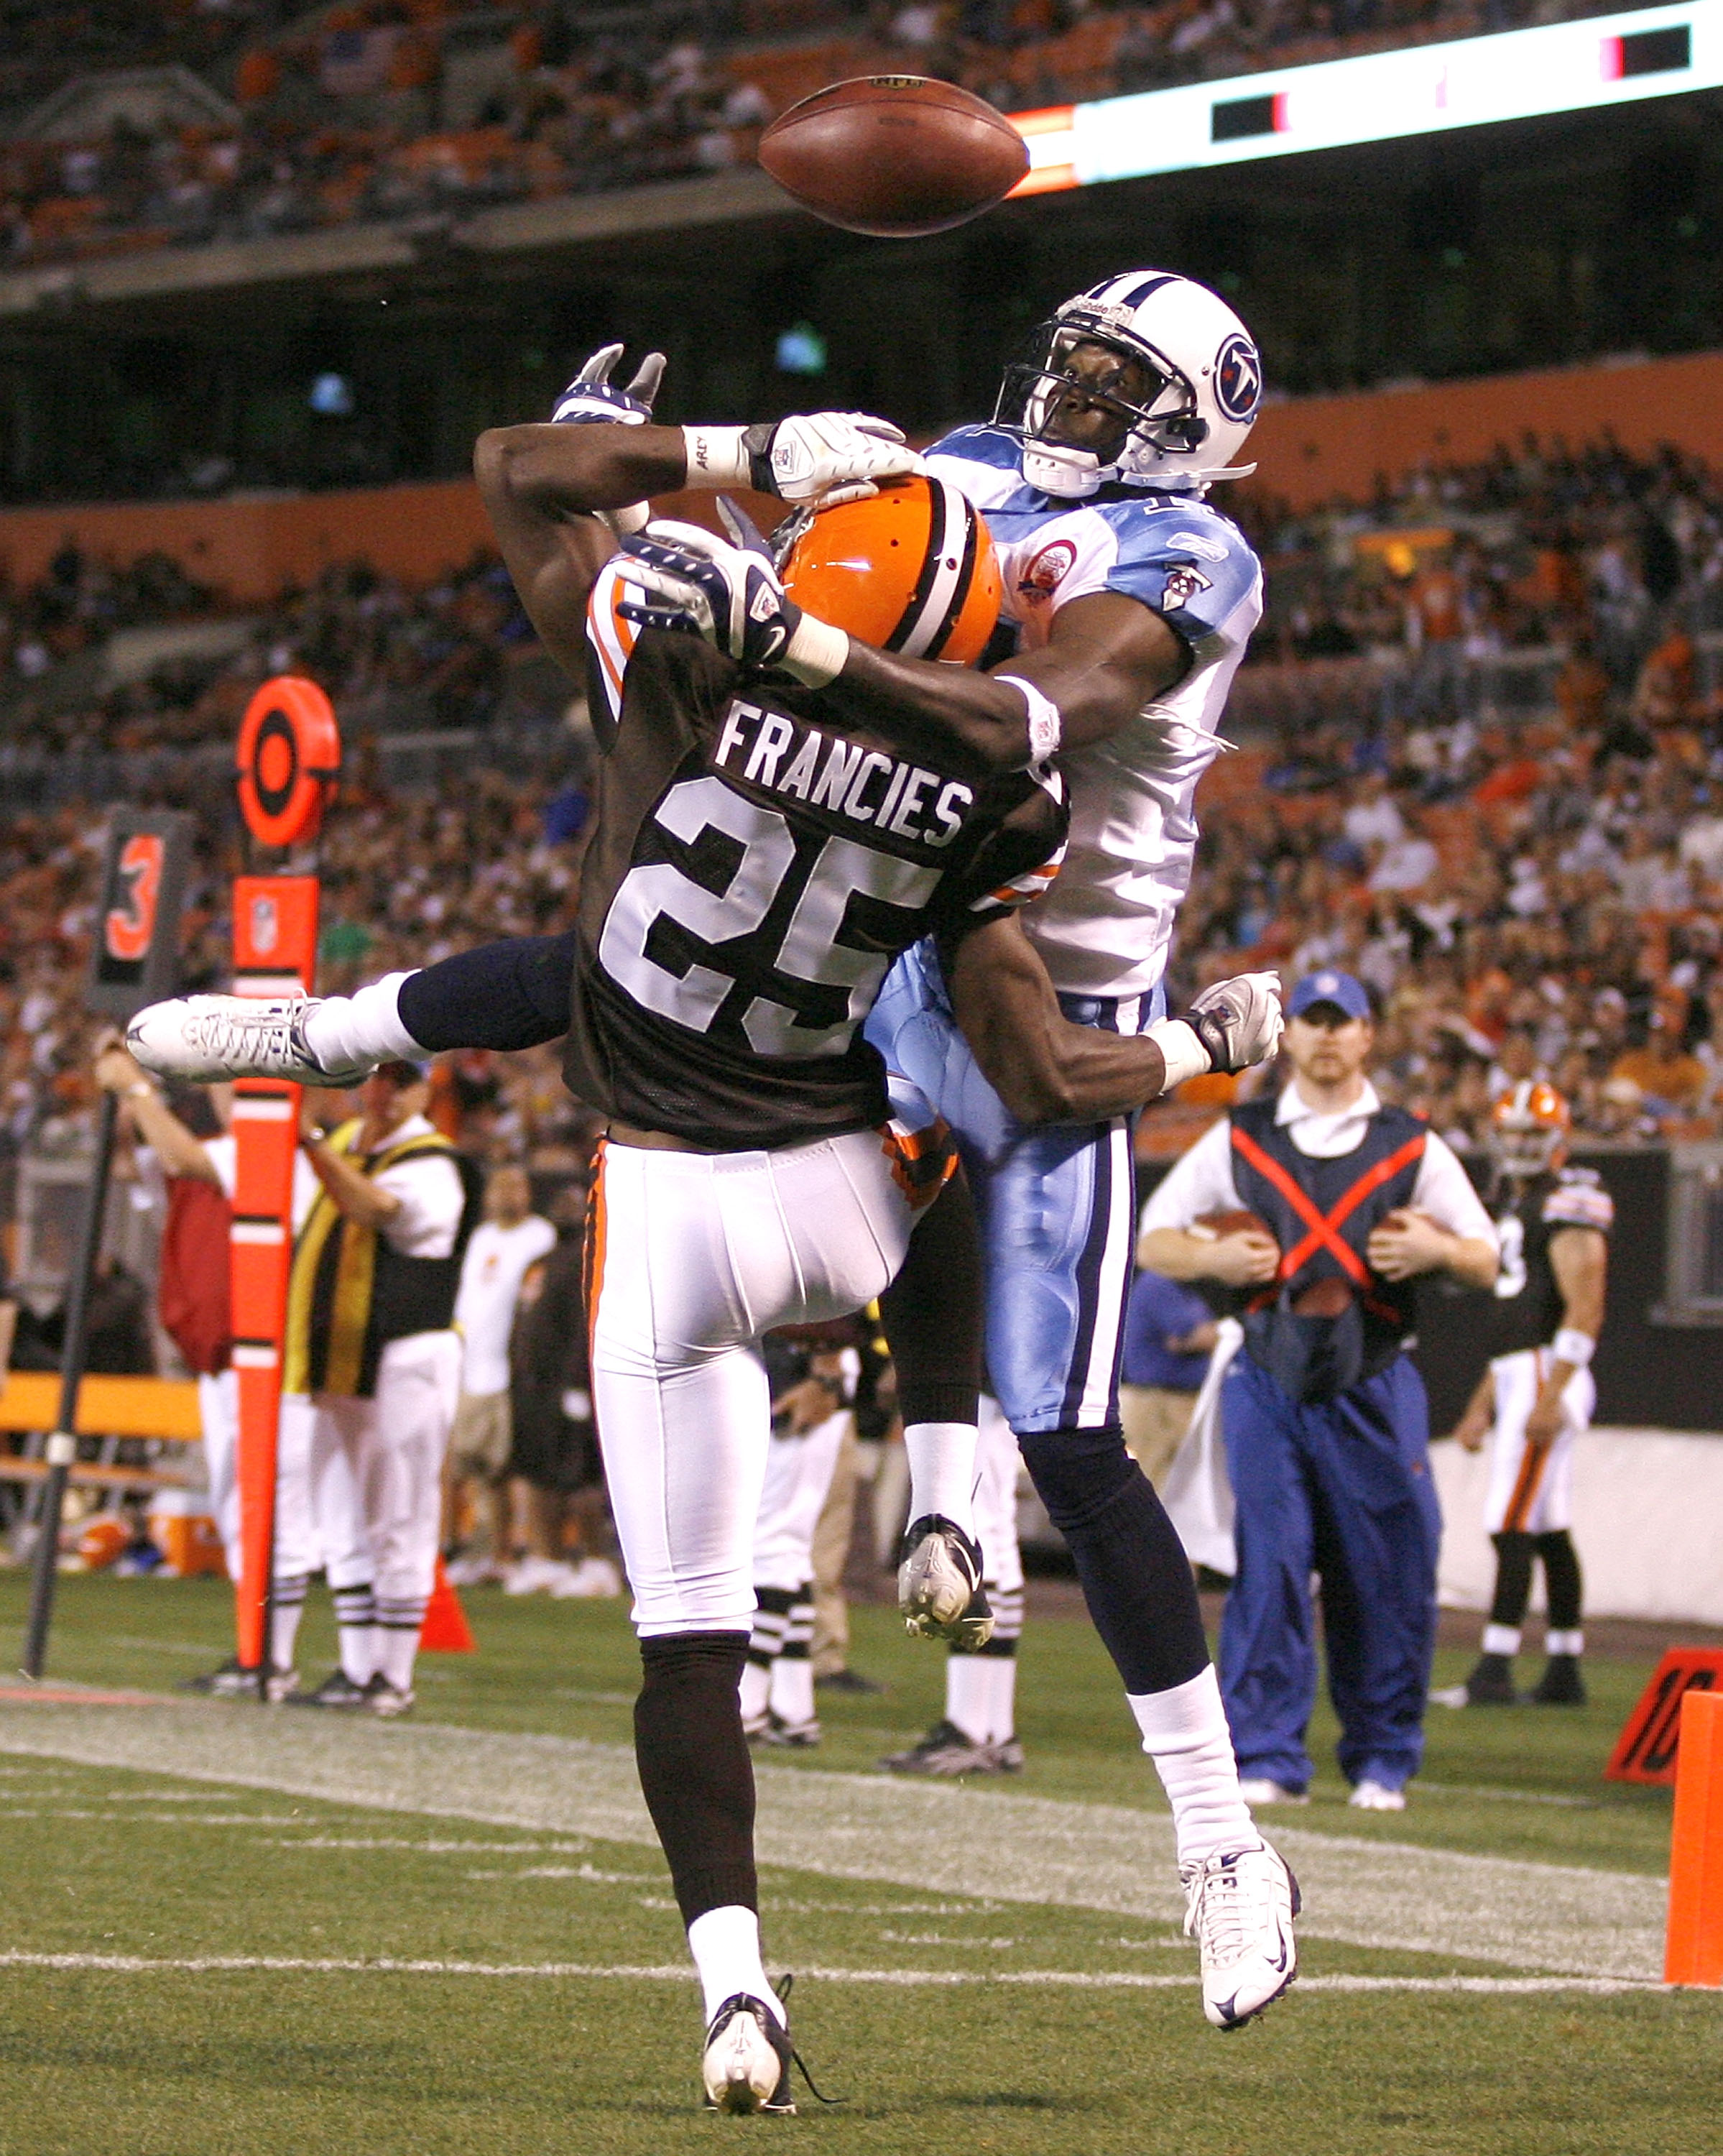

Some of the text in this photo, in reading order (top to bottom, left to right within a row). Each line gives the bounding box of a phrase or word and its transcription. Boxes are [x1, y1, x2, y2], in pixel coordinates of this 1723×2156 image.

[715, 700, 974, 848] FRANCIES
[105, 832, 165, 960] 3
[599, 776, 944, 1055] 25
